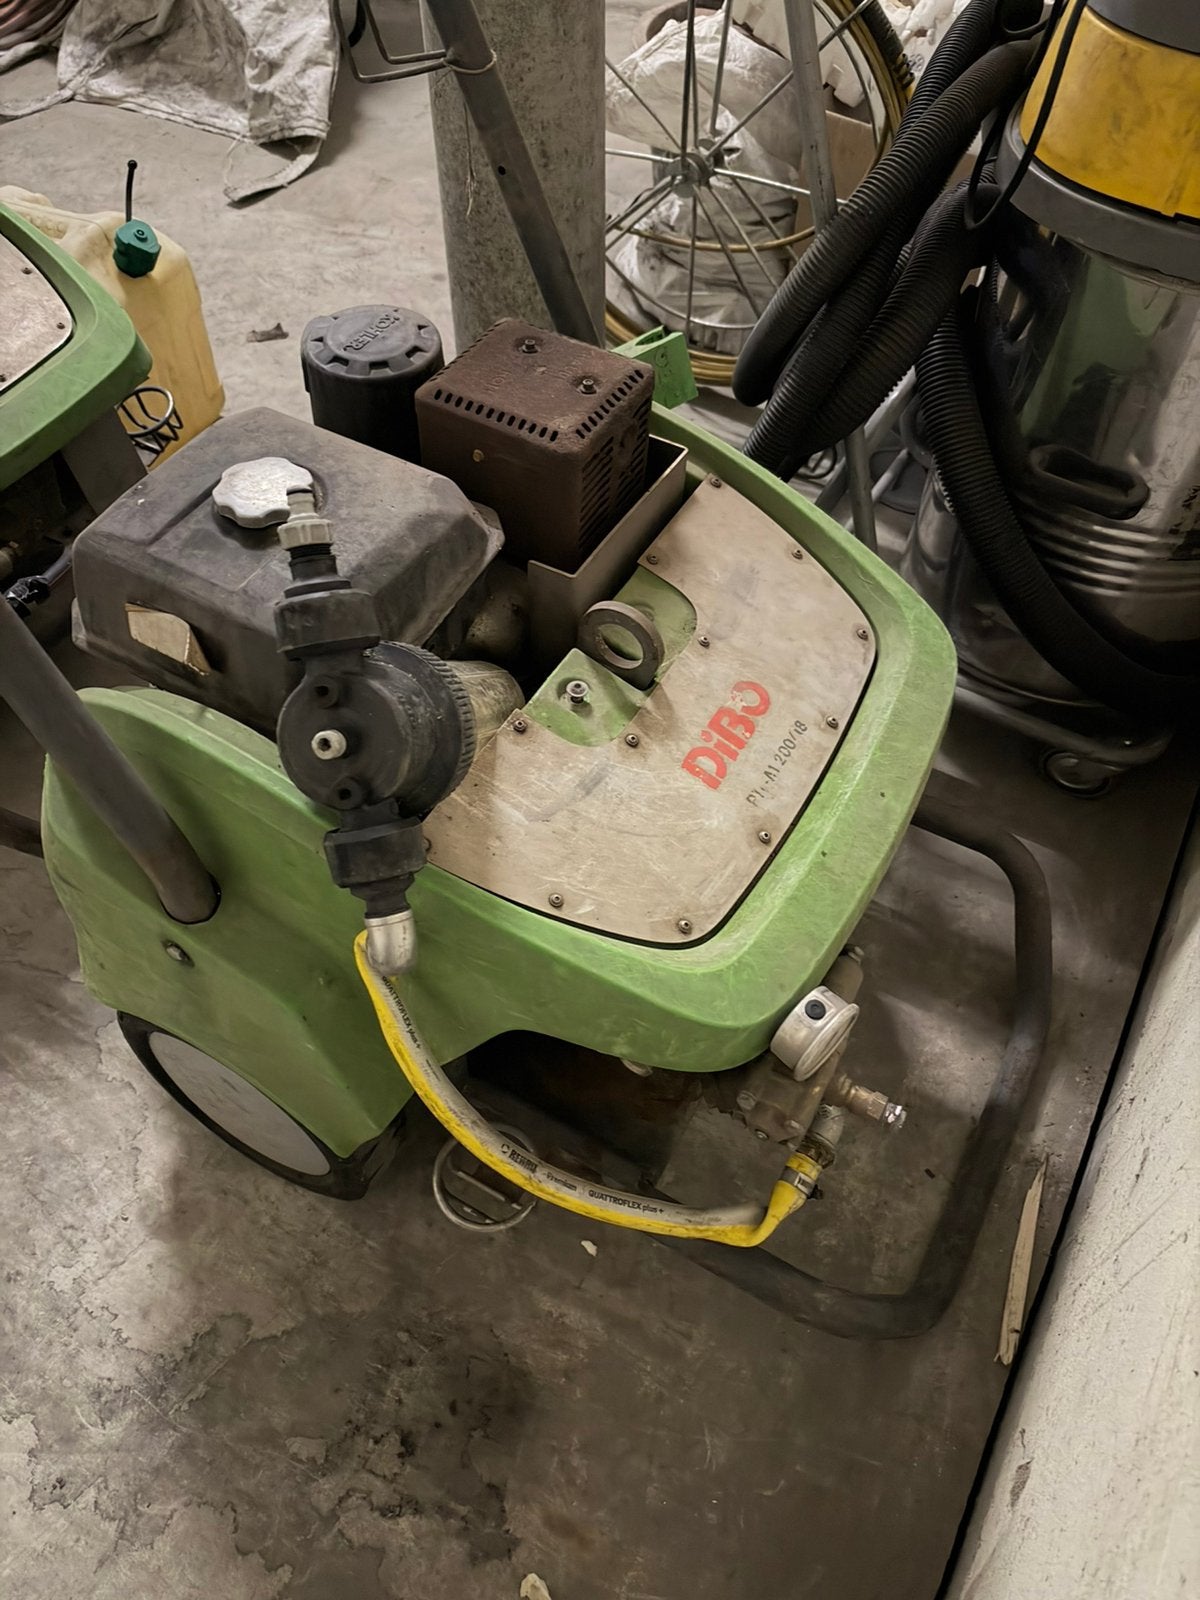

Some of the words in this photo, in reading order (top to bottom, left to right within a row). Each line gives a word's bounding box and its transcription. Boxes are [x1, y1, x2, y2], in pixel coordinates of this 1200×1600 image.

[343, 314, 401, 352] KOHLER
[774, 720, 808, 766] 200/18
[588, 1189, 642, 1211] QUATTROFLEX
